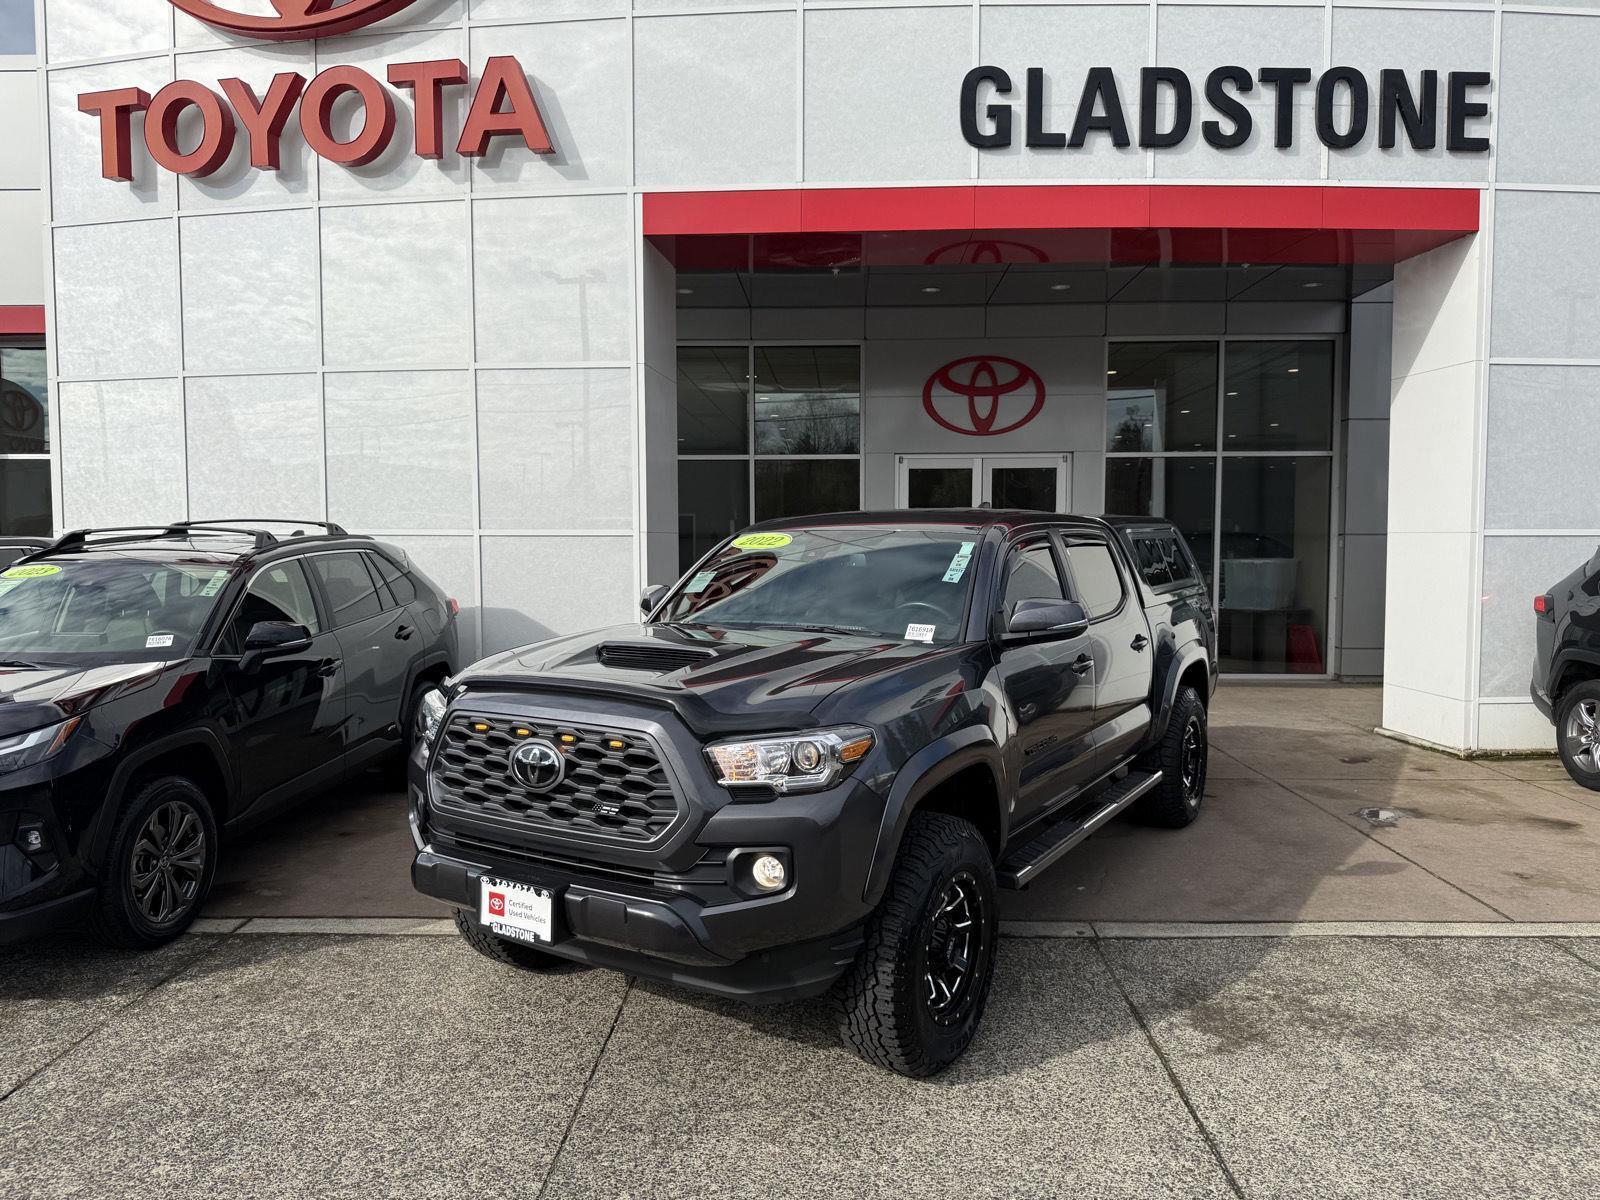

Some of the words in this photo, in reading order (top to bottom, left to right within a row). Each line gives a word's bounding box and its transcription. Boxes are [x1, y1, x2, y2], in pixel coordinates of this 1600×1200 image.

[959, 65, 1491, 152] GLADSTONE
[77, 55, 556, 183] TOYOTA
[738, 535, 785, 547] 2022
[495, 878, 534, 893] TOYOTA
[508, 899, 533, 911] Certified
[508, 908, 523, 918] Used
[523, 912, 546, 924] Vehicles
[492, 922, 535, 942] GLADSTONE
